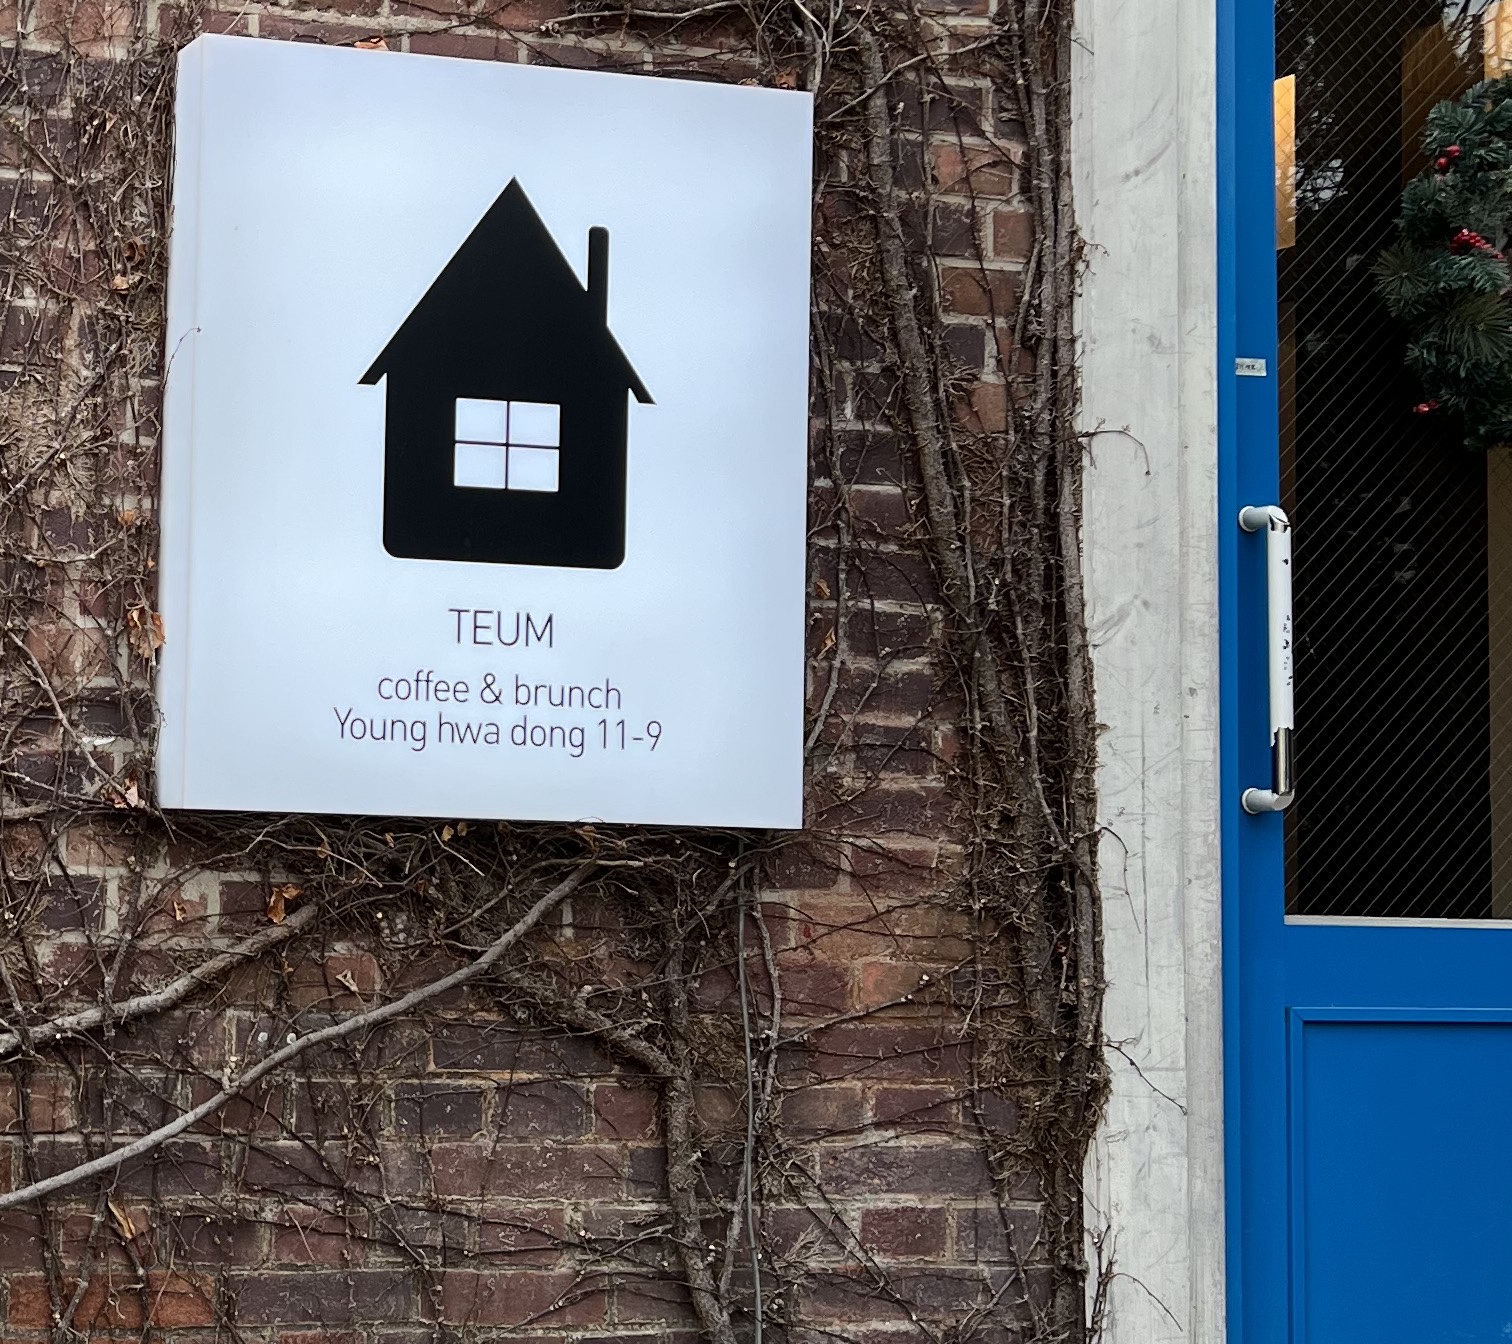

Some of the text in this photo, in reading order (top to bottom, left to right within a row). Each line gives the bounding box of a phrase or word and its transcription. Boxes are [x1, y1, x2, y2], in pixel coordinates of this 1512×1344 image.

[448, 608, 554, 649] TEUM
[377, 669, 621, 710] coffee & brunch
[333, 707, 662, 758] Young hwa dong 11-9
